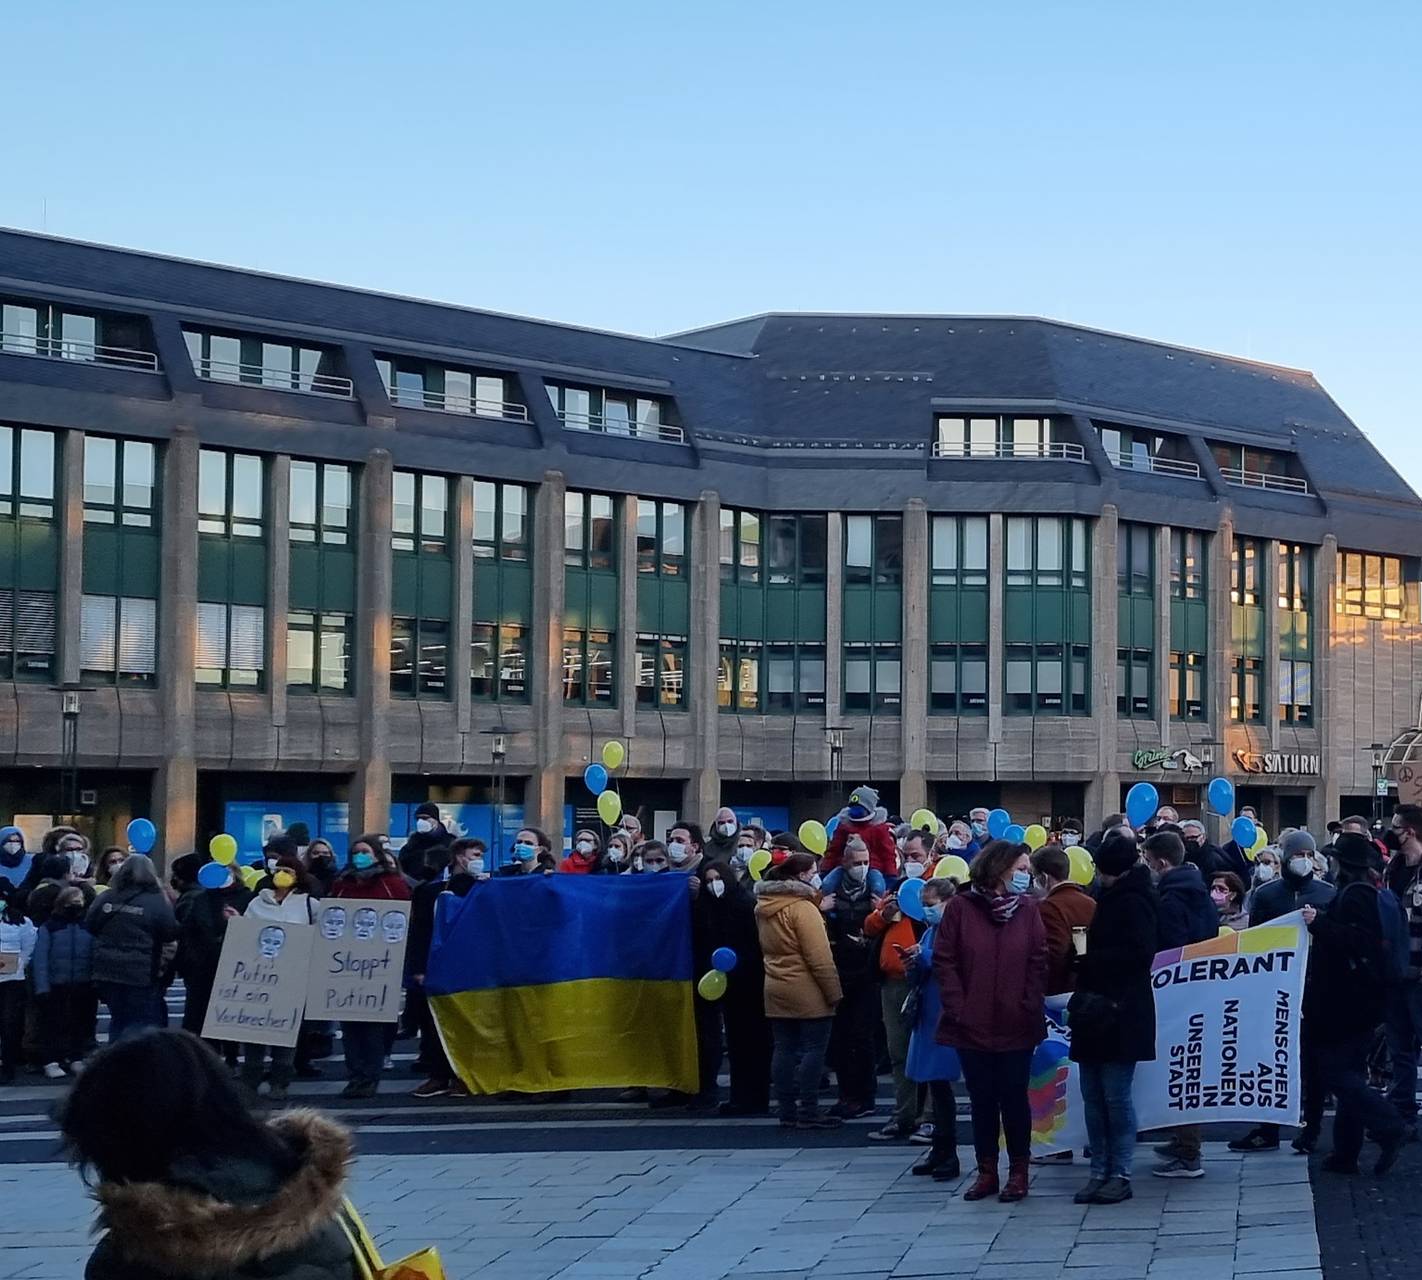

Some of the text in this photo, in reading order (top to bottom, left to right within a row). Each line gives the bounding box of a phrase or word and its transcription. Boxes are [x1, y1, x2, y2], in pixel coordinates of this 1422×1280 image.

[1264, 753, 1319, 774] SATURN
[232, 961, 279, 985] Putin
[328, 949, 391, 981] Stoppt
[1150, 951, 1296, 990] OLERANT
[218, 984, 270, 1003] ist ein
[325, 984, 388, 1012] Putin!
[214, 1006, 298, 1030] Verbrecher!
[1185, 1013, 1204, 1110] UNSERER
[1221, 1000, 1239, 1107] NATIONEN
[1274, 990, 1290, 1109] MENSCHEN
[1168, 1045, 1185, 1111] STADT
[1239, 1070, 1255, 1107] 120
[1256, 1062, 1274, 1108] AUS
[1203, 1085, 1219, 1107] IN
